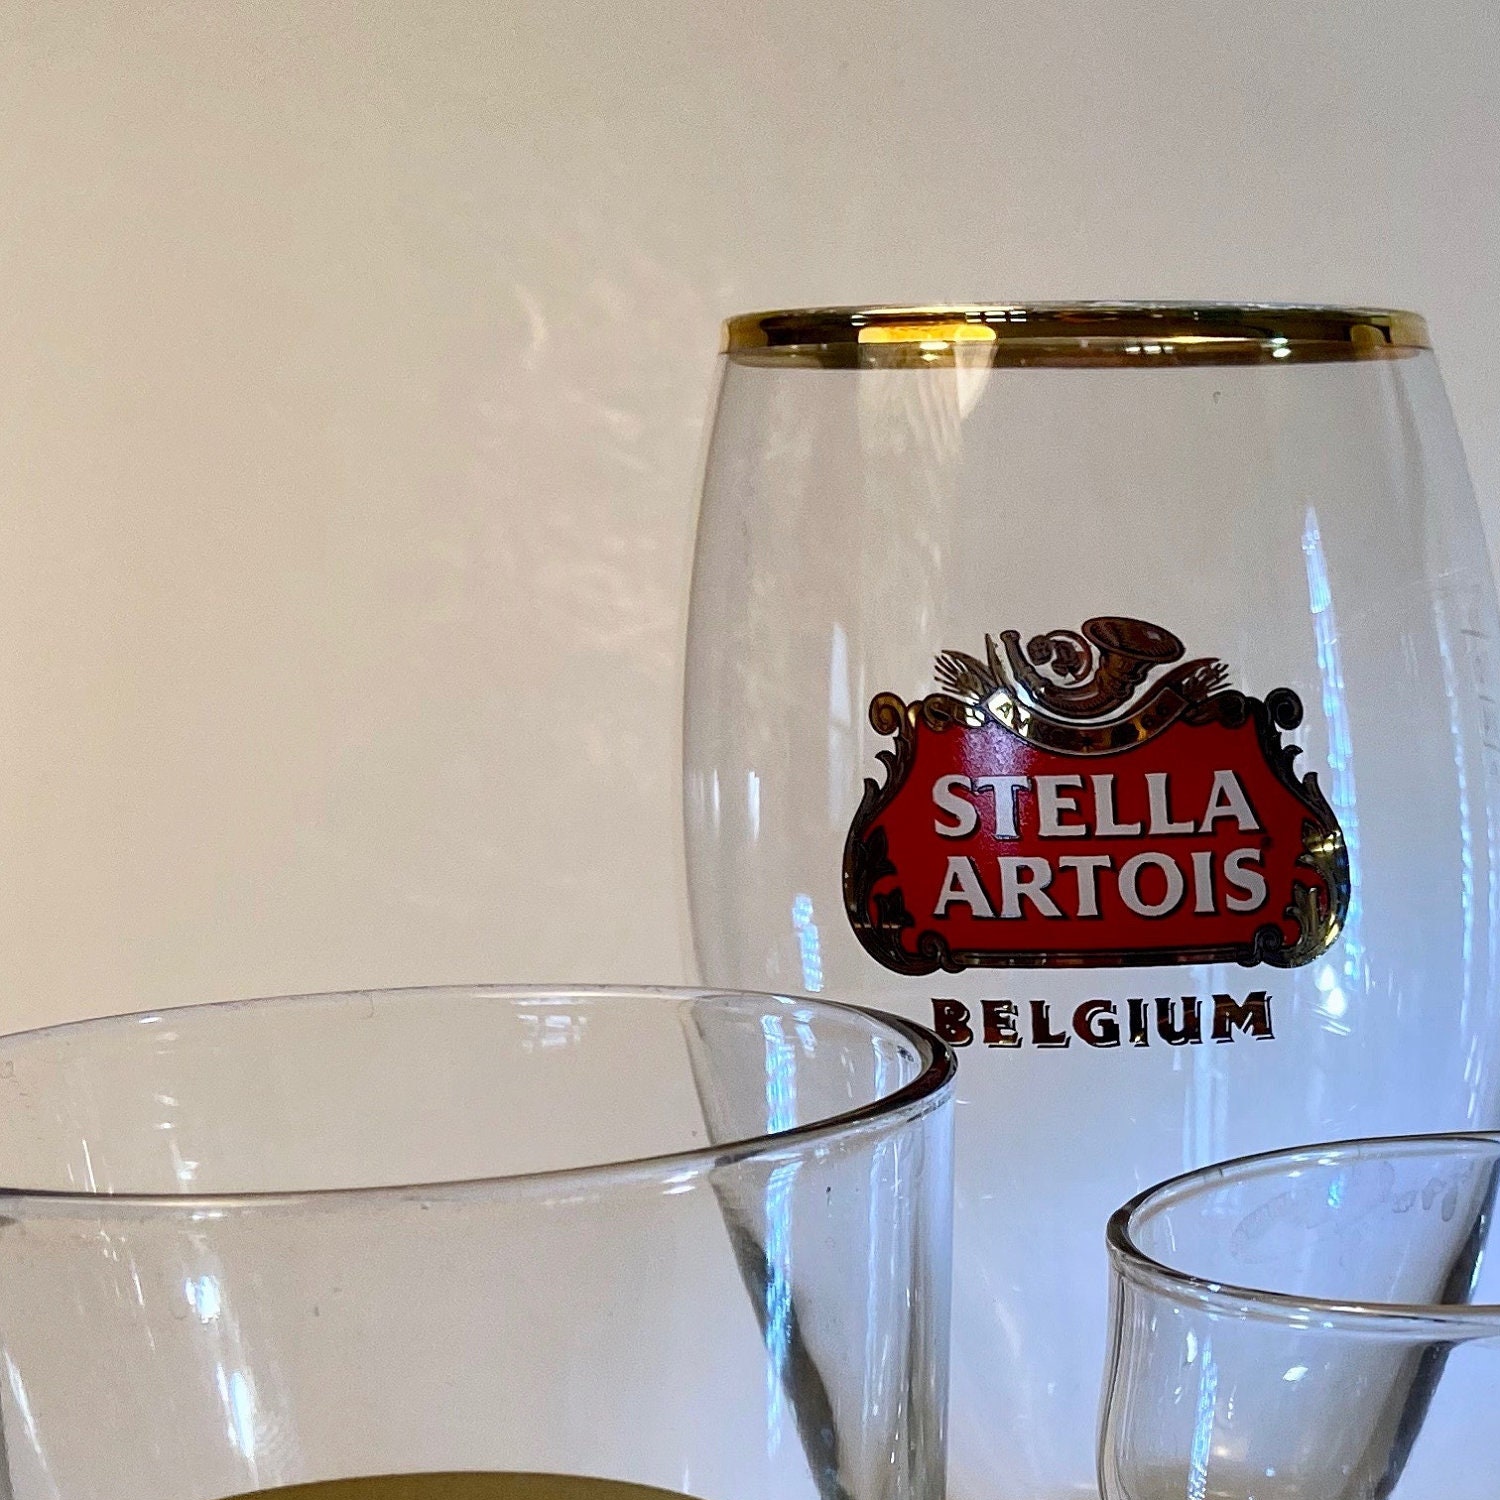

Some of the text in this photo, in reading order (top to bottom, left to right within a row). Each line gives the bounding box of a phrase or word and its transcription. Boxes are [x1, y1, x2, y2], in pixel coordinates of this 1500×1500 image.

[932, 769, 1262, 841] STELLA
[933, 847, 1269, 920] ARTOIS
[931, 990, 1276, 1049] BELGIUM
